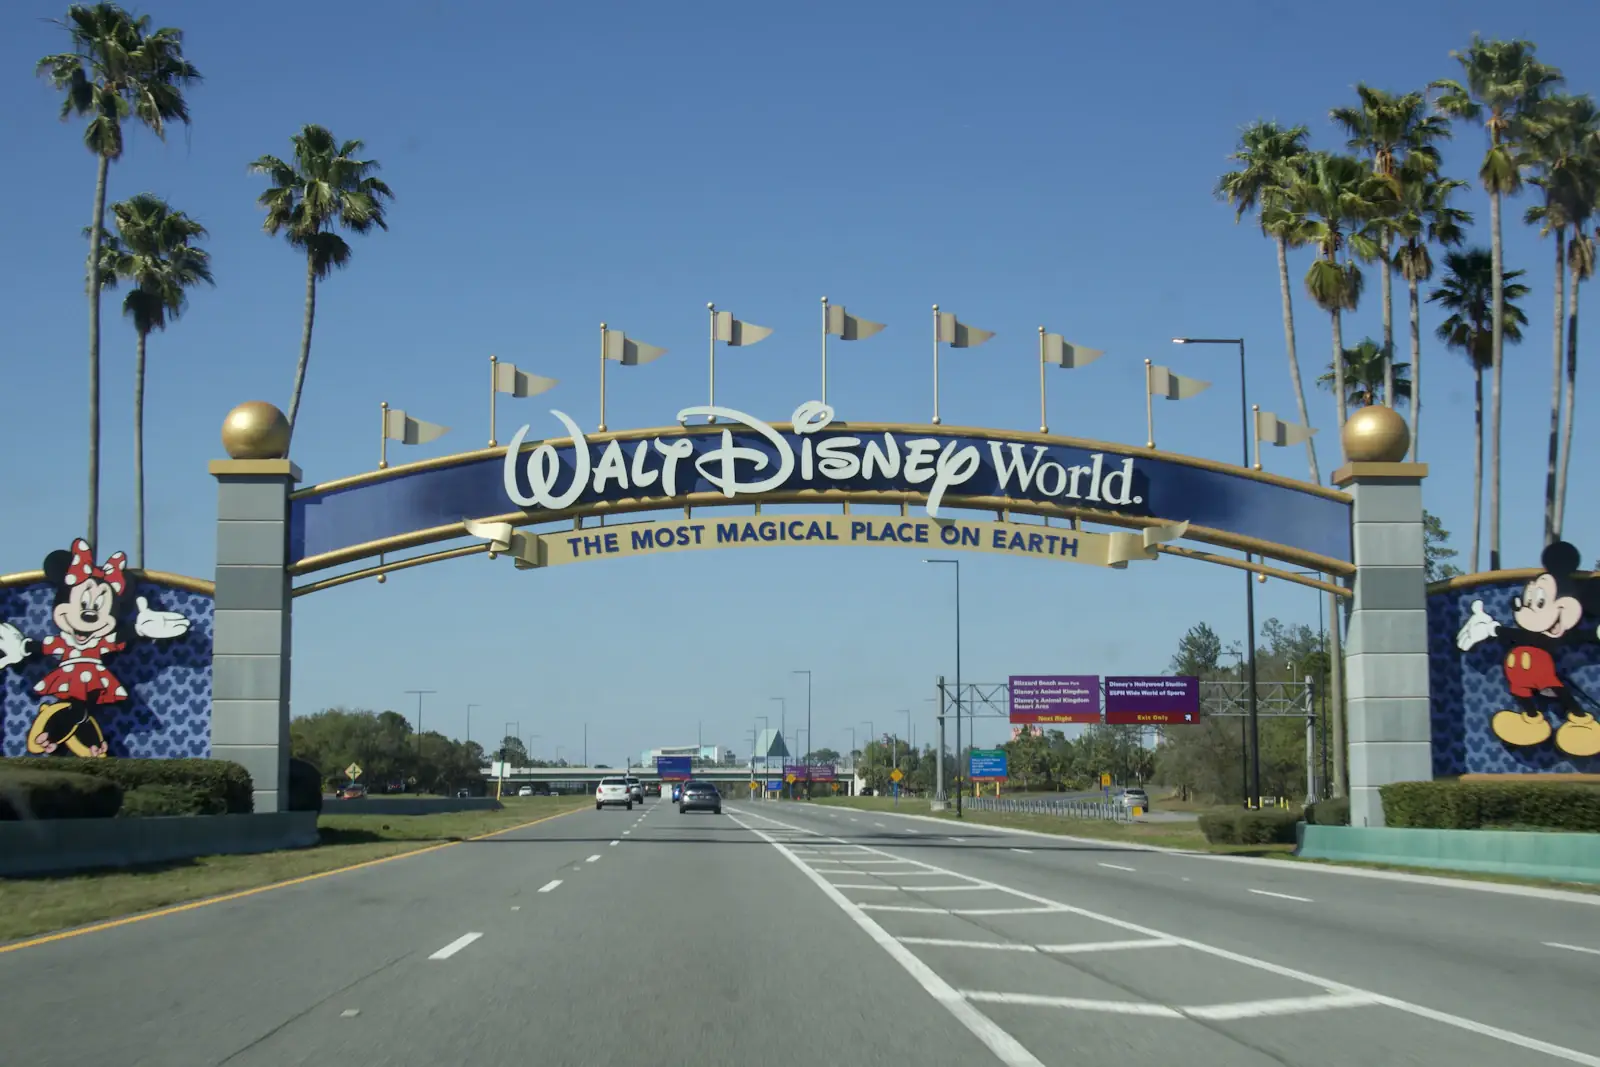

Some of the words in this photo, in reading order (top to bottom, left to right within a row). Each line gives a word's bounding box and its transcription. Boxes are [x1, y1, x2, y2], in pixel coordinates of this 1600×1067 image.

[567, 533, 620, 557] THE
[631, 525, 705, 550] MOST
[716, 521, 839, 543] MAGICAL
[851, 521, 929, 543] PLACE
[940, 525, 980, 547] ON
[992, 529, 1078, 557] EARTH
